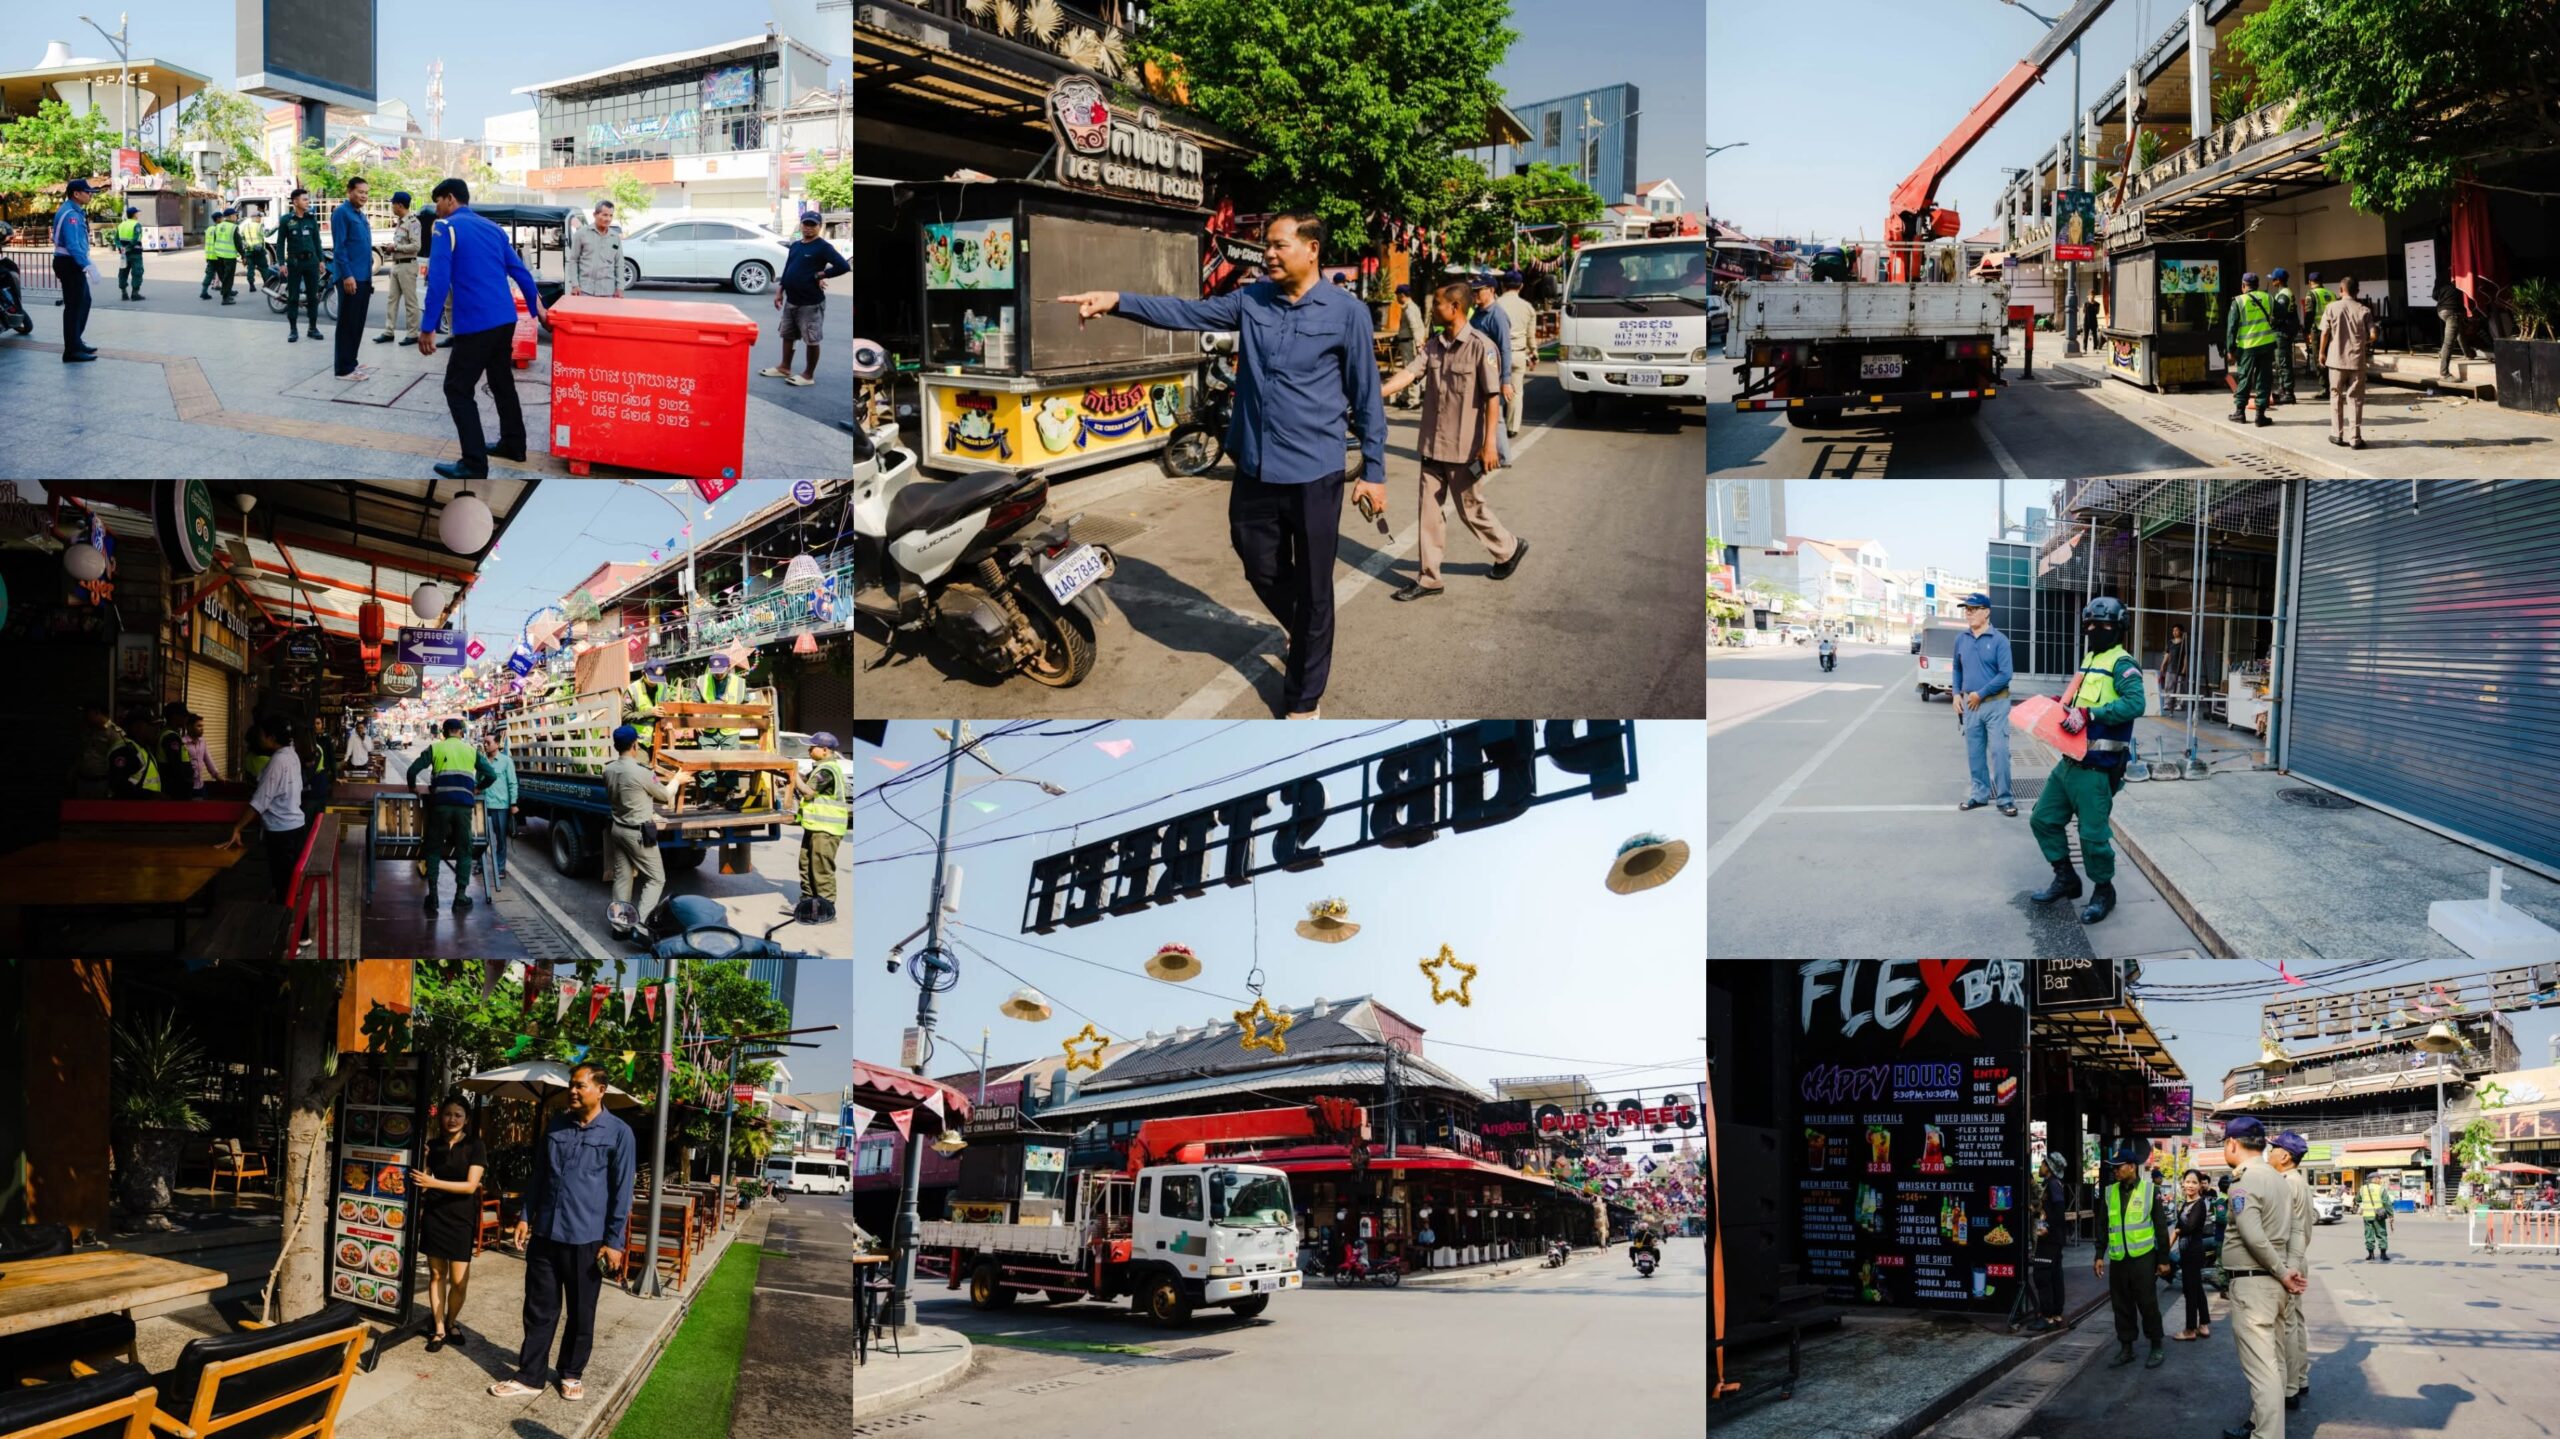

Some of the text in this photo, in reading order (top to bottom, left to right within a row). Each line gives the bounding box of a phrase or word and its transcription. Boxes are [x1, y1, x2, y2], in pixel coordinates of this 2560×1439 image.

[1067, 155, 1202, 201] ICE CREAM ROLLS
[1863, 362, 1900, 375] 3G-6305
[1054, 556, 1100, 598] 1AQ-7843
[204, 596, 249, 642] HOT STONE
[423, 655, 441, 664] EXIT
[2044, 974, 2072, 990] Bar
[1973, 1056, 1995, 1066] FREE
[1973, 1067, 2008, 1079] ENTRY
[1801, 1063, 1962, 1104] HAPPY HOURS
[1973, 1082, 1991, 1092] ONE
[1973, 1095, 1995, 1104] SHOT
[1541, 1105, 1691, 1132] PUB STREET
[1863, 1114, 1903, 1122] COCKTAILS
[1935, 1114, 2005, 1122] MIXED DRINKS JUG
[1482, 1121, 1527, 1136] Angkor
[1868, 1163, 1891, 1172] $2.50
[1920, 1163, 1944, 1172] $7.00
[1897, 1182, 1974, 1190] WHISKEY BOTTLE
[1972, 1216, 1989, 1225] FREE
[1915, 1226, 1938, 1234] BEAM
[1918, 1236, 1942, 1246] LABEL
[1915, 1254, 1952, 1264] ONE SHOT
[1987, 1265, 2014, 1275] $2.25
[1944, 1280, 1961, 1288] JOSS
